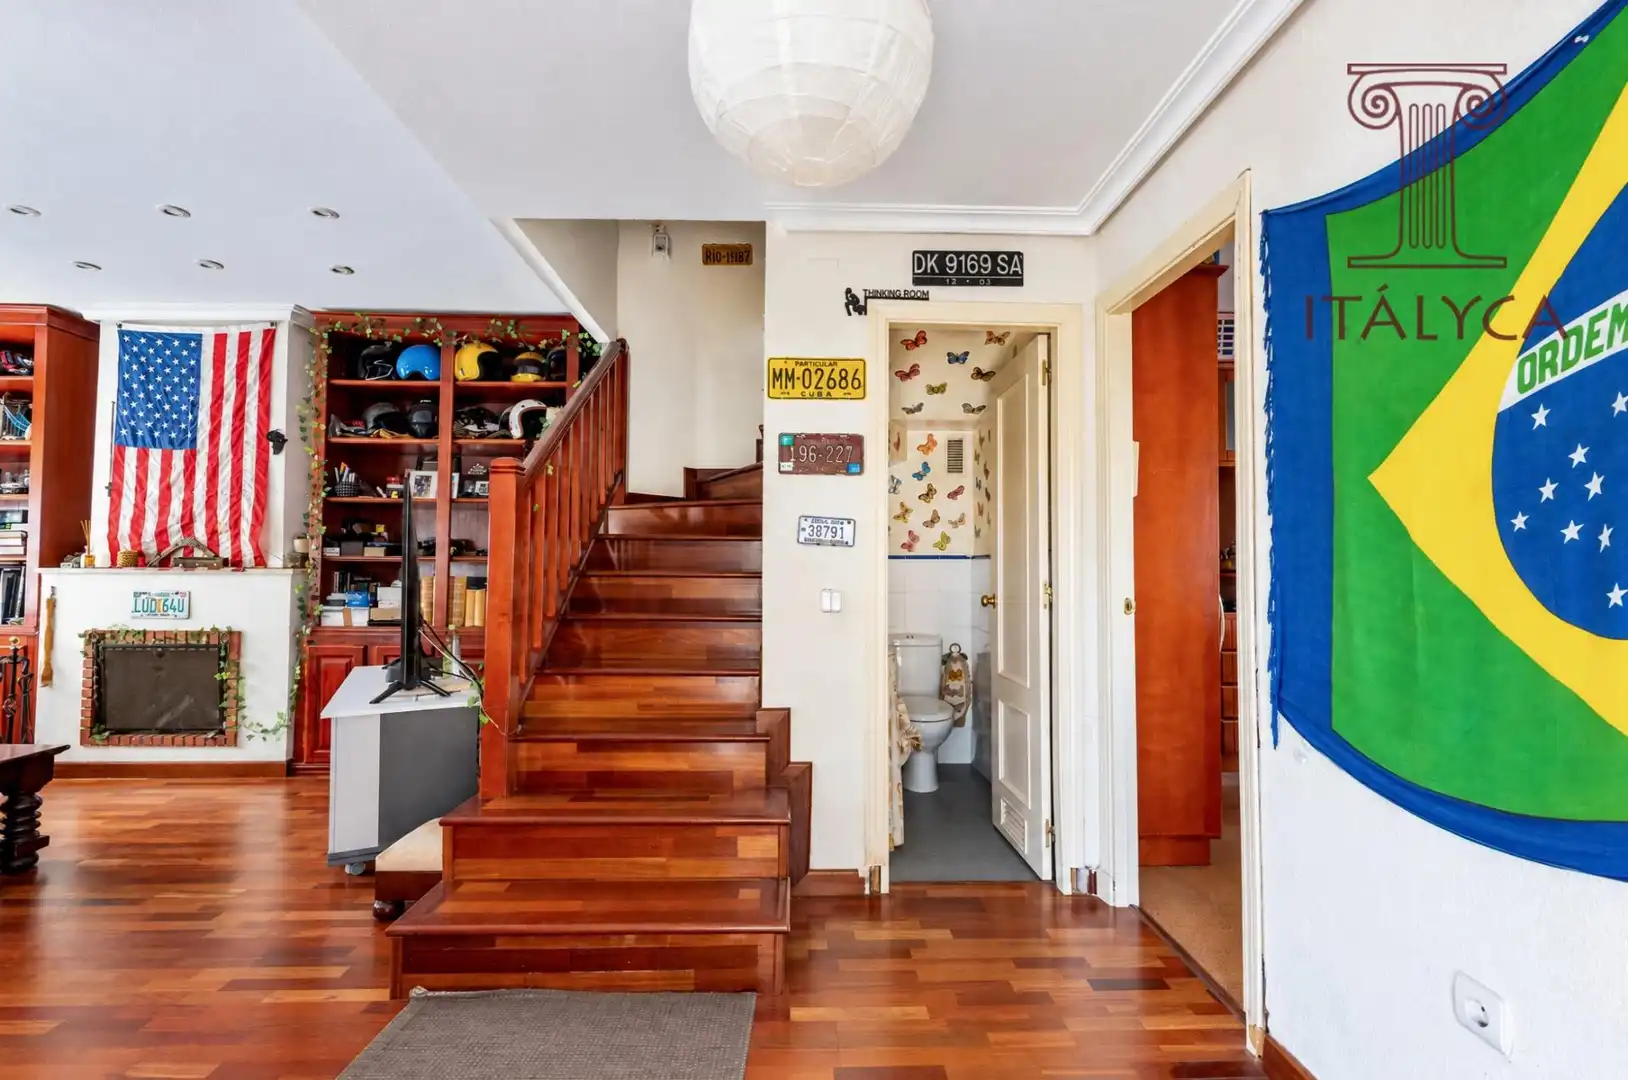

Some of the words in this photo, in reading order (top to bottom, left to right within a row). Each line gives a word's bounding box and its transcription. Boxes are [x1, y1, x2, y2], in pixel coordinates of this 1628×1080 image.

[914, 253, 940, 274] DK
[945, 253, 992, 274] 9169
[996, 254, 1023, 275] SA
[862, 289, 902, 298] THINKING
[903, 290, 930, 299] ROOM
[1517, 303, 1628, 395] ORDEM
[772, 367, 862, 390] MM-02686
[790, 445, 853, 463] 196-227
[808, 524, 845, 540] 38791
